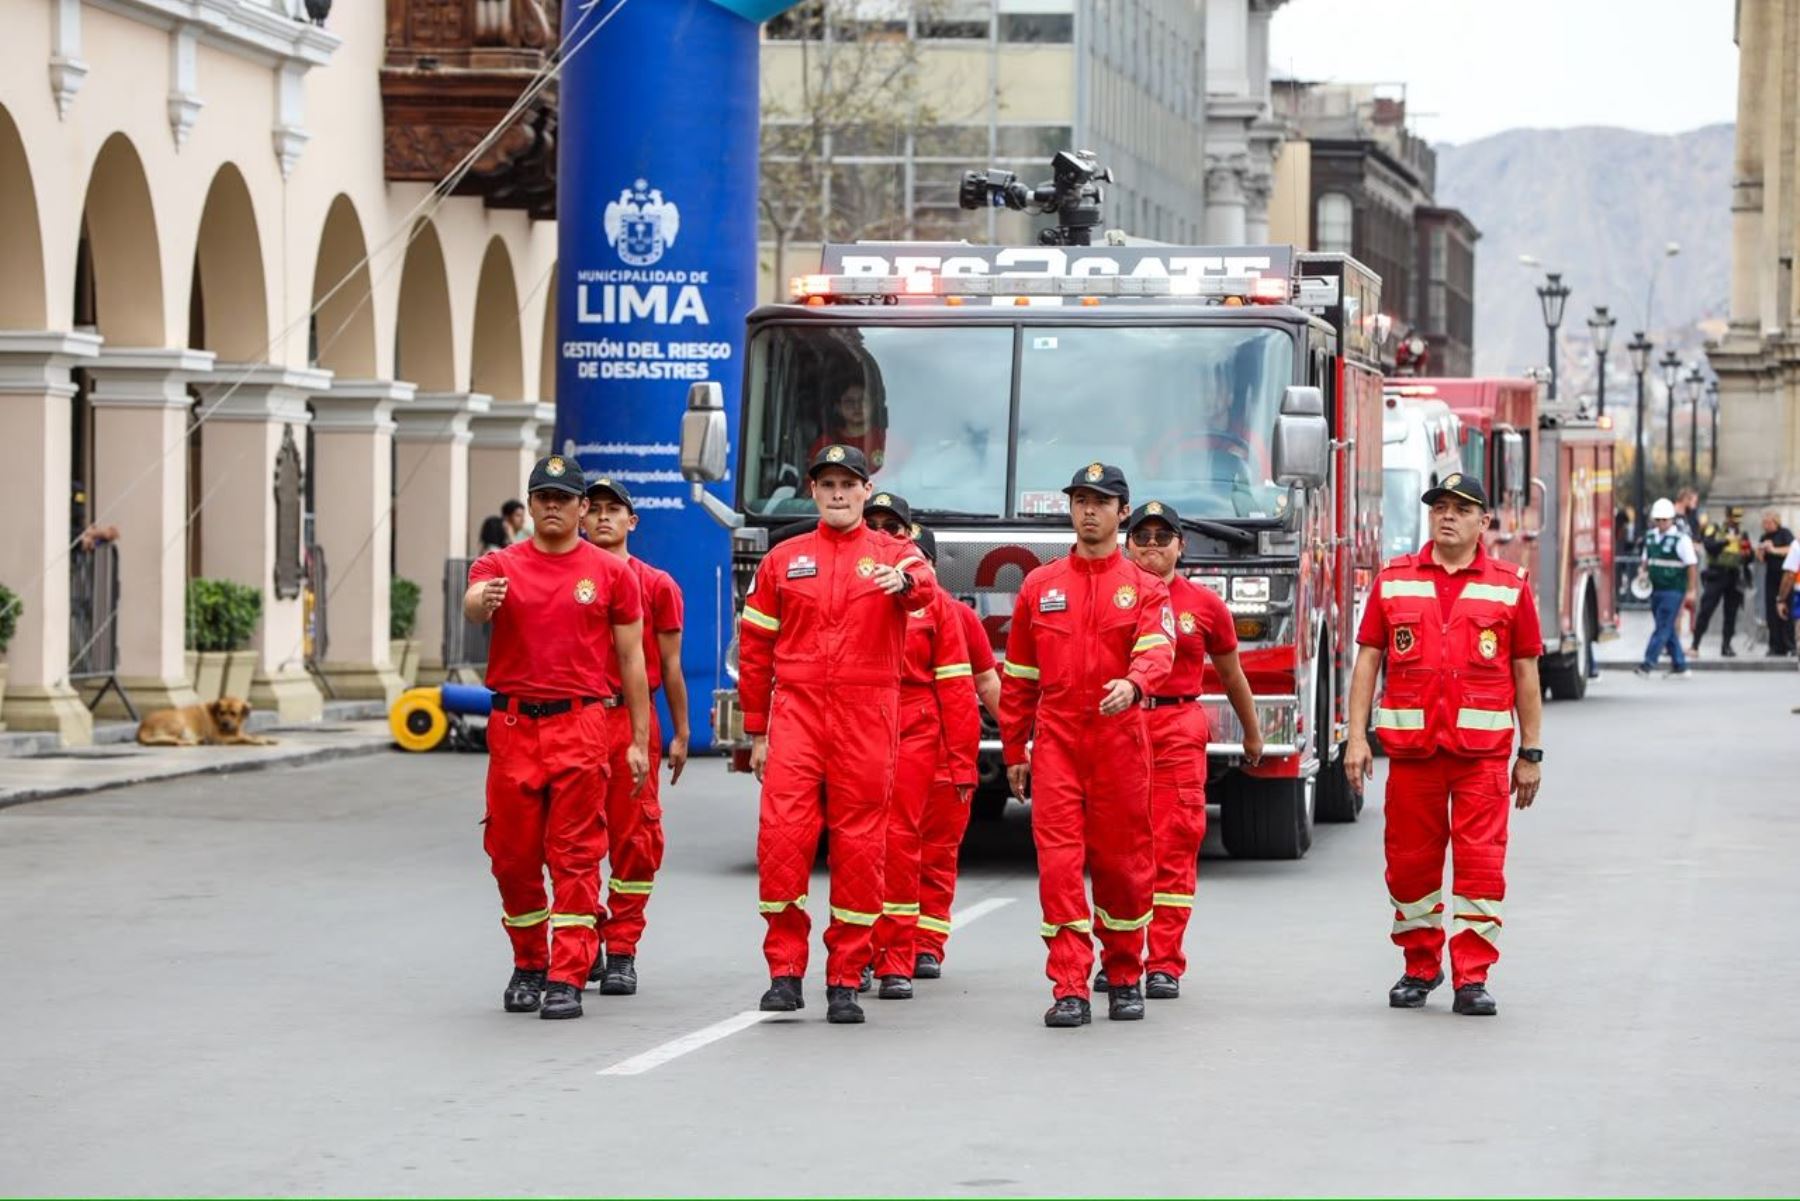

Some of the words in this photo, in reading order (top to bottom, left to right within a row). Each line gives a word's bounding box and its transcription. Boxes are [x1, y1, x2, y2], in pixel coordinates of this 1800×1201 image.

[577, 270, 687, 284] MUNICIPALIDAD
[689, 271, 709, 284] DE
[577, 284, 710, 325] LIMA
[563, 338, 625, 359] GESTIÓN
[627, 342, 665, 359] DEL
[668, 342, 732, 360] RIESGO
[578, 361, 599, 379] DE
[601, 361, 709, 380] DESASTRES
